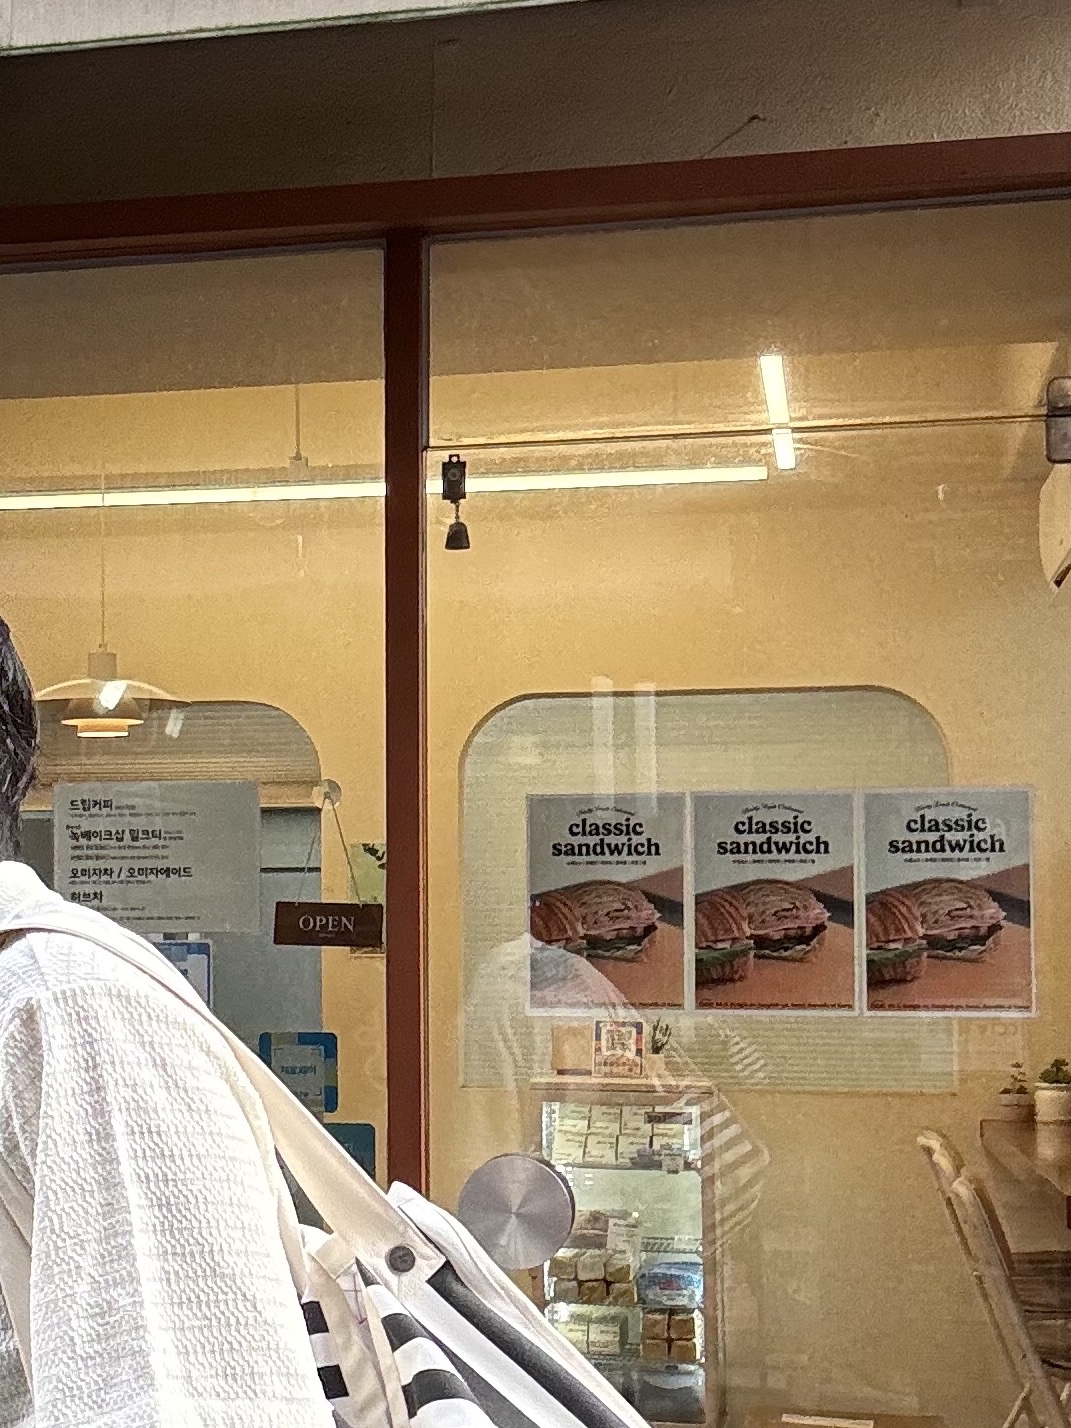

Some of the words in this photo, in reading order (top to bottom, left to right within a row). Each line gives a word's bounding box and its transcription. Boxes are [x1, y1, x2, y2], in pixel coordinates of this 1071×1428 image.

[68, 798, 113, 812] 드립커피
[568, 818, 644, 837] classic
[733, 814, 812, 835] classic
[906, 812, 988, 833] classic
[551, 837, 661, 857] sandwich
[716, 835, 830, 855] sandwich
[887, 833, 1006, 854] sandwich
[69, 866, 114, 879] 오미자차
[126, 866, 193, 879] 오미자에이드
[299, 914, 356, 932] OPEN
